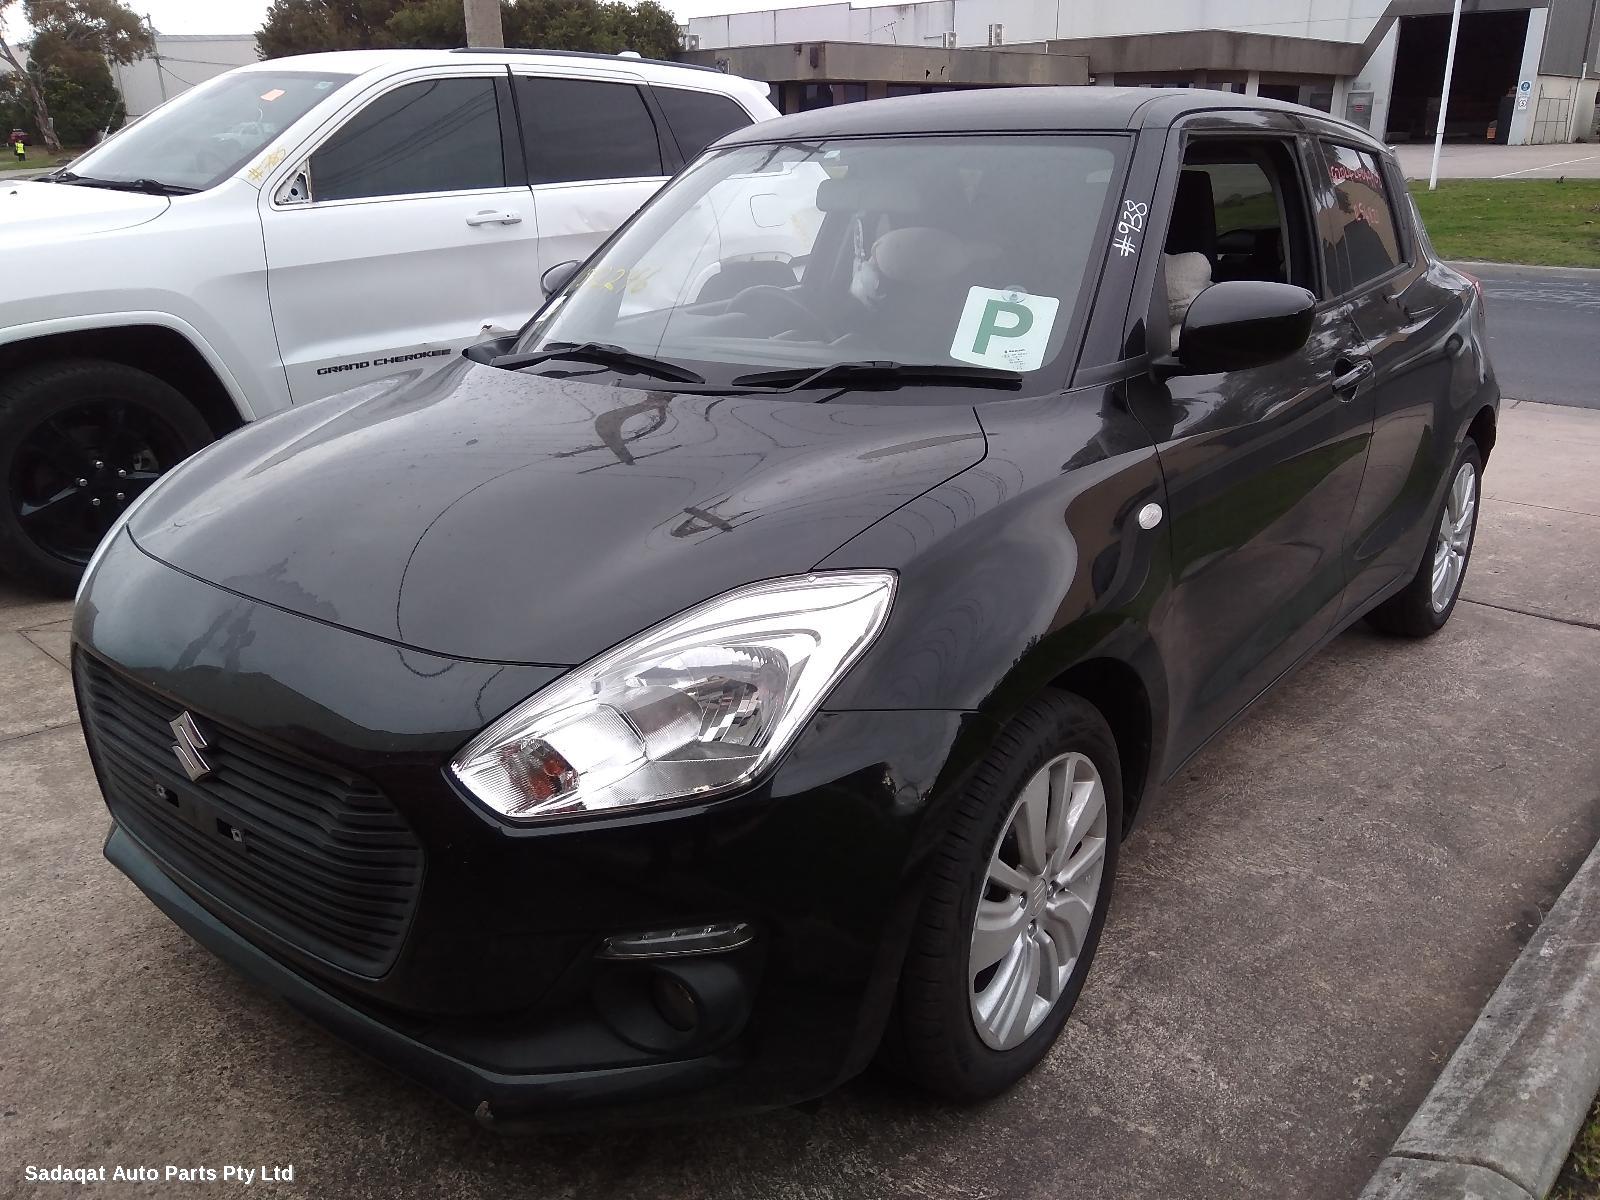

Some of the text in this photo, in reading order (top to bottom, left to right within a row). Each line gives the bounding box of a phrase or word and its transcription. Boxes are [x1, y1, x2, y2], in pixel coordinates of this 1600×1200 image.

[1113, 200, 1147, 256] #938
[972, 299, 1033, 354] P
[317, 349, 451, 375] GRAND CHEROKEE
